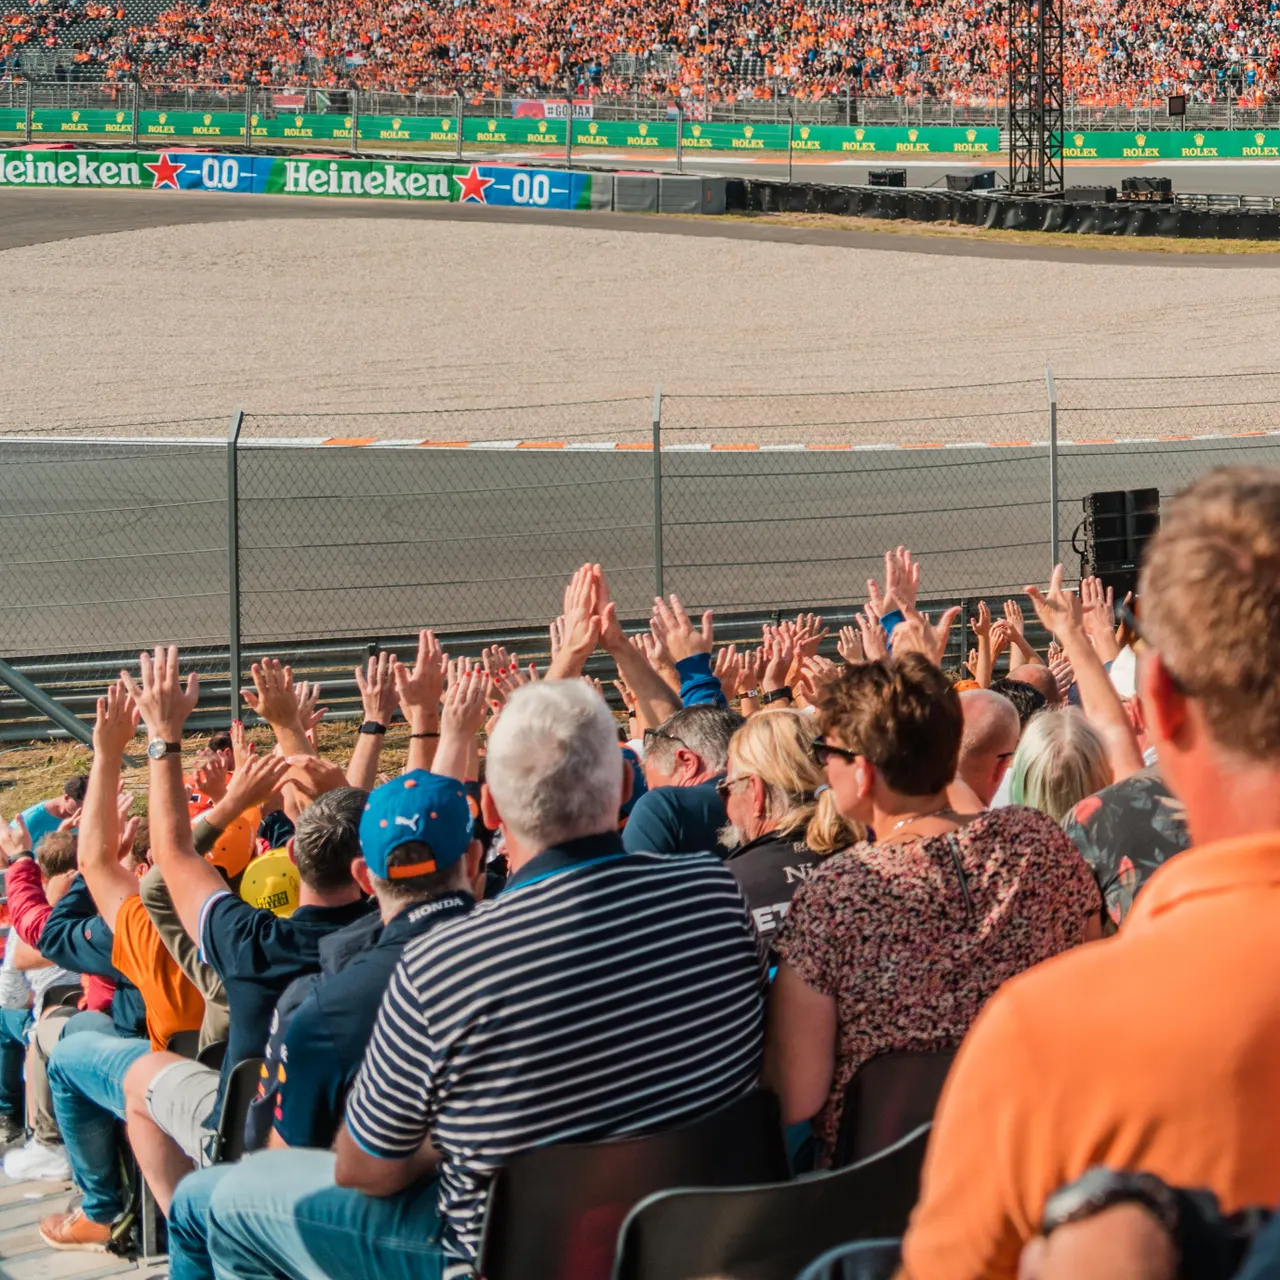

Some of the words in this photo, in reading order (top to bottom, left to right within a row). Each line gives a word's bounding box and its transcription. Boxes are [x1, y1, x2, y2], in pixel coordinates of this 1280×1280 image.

[16, 122, 43, 130] ROEX
[61, 122, 88, 131] ROLEX
[105, 123, 132, 132] ROLEX
[148, 125, 175, 134] ROLEX
[193, 126, 220, 135] ROLEX
[240, 127, 268, 136] RLEX
[284, 128, 312, 137] ROLEX
[333, 129, 362, 138] ROLX
[380, 130, 409, 139] ROLEX
[430, 132, 458, 140] ROLEX
[477, 133, 506, 142] ROLEX
[527, 134, 557, 143] ROLEX
[577, 135, 608, 145] ROLEX
[627, 136, 658, 146] ROLEX
[681, 138, 713, 147] ROLEX
[732, 139, 764, 148] ROLEX
[842, 142, 875, 151] ROLEX
[896, 143, 930, 152] ROLEX
[954, 143, 988, 152] ROLEX
[1062, 147, 1098, 157] ROLEX
[1123, 147, 1159, 157] ROLEX
[1181, 147, 1218, 156] ROLEX
[1242, 146, 1279, 156] ROLEX
[202, 157, 239, 190] 0.0
[284, 161, 451, 197] Heineken
[512, 172, 550, 206] 0.0
[408, 896, 464, 923] HONDA
